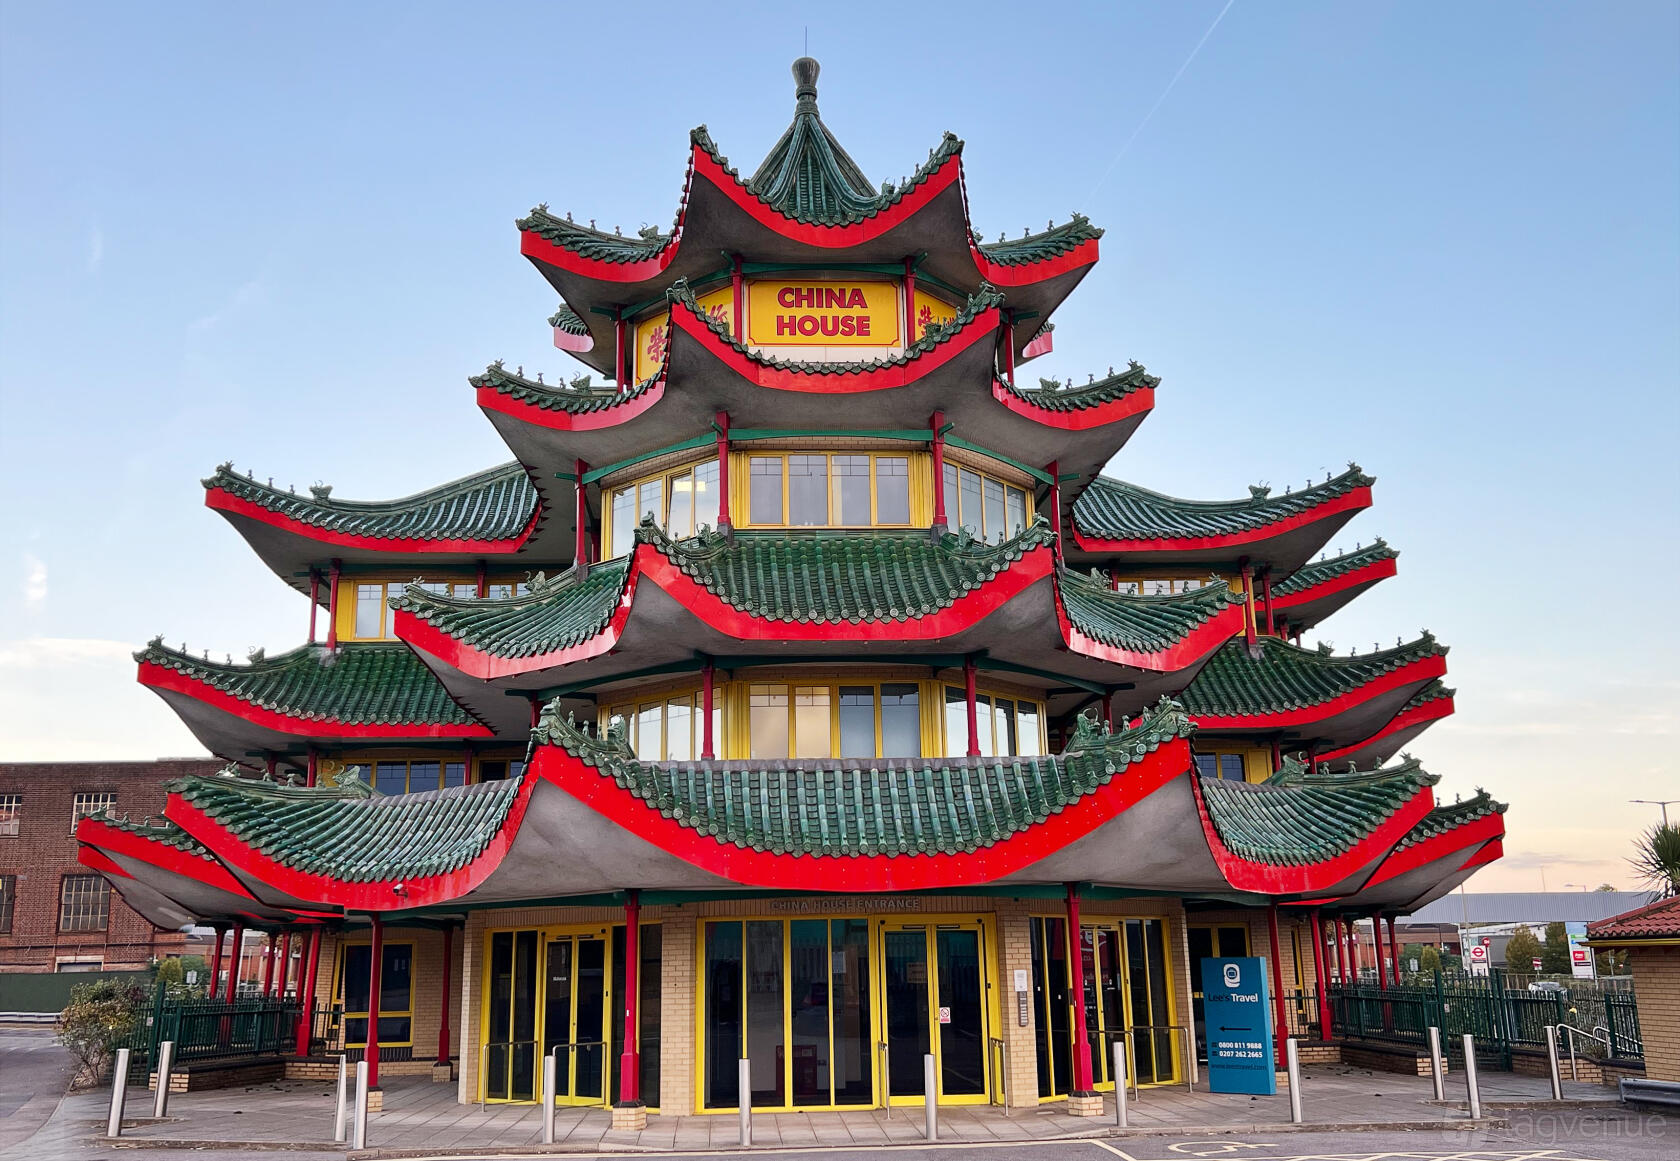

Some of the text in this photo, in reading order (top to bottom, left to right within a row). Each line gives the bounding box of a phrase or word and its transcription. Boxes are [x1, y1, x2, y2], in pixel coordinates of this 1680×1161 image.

[777, 287, 868, 309] CHINA
[776, 315, 871, 337] HOUSE
[771, 899, 919, 910] CHINA HOUSE ENTRANCE
[1208, 992, 1259, 1003] Lee's Travel
